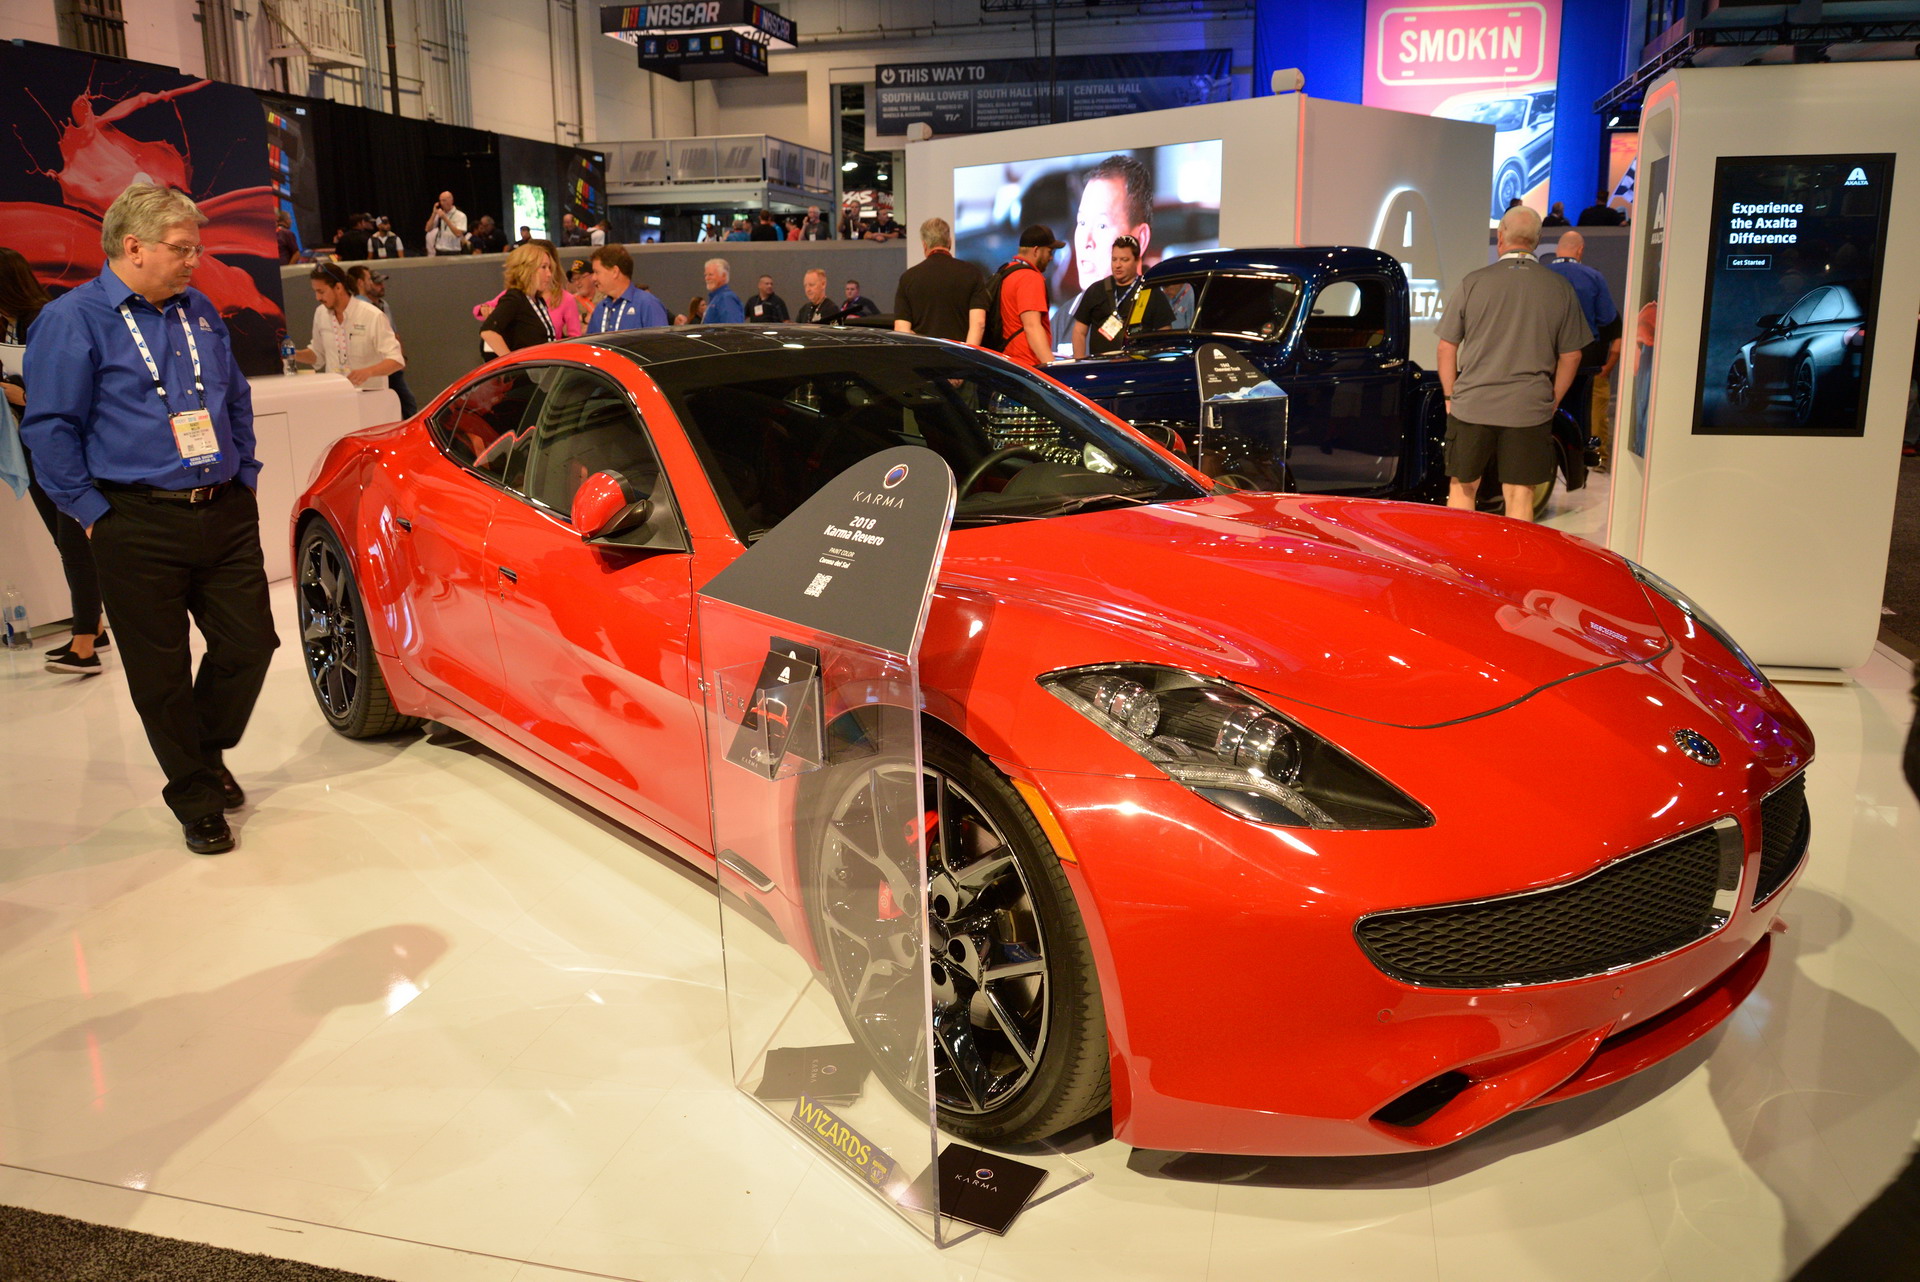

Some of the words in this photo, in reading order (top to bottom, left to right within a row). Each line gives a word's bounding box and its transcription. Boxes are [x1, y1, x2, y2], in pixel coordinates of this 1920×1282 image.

[646, 1, 720, 27] NASCAR
[763, 9, 790, 41] NASCAR
[1399, 25, 1523, 64] SMOK1N
[898, 68, 929, 84] THIS
[932, 66, 964, 82] WAY
[968, 65, 985, 80] TO
[881, 92, 912, 103] SOUTH
[913, 91, 936, 102] HALL
[937, 90, 969, 101] LOWER
[977, 88, 1007, 99] SOUTH
[1009, 87, 1032, 98] HALL
[1074, 84, 1116, 96] CENTRAL
[1117, 83, 1142, 94] HALL
[1732, 201, 1804, 216] Experience
[1730, 217, 1753, 229] the
[1755, 216, 1798, 229] Axalta
[1729, 232, 1798, 244] Difference
[852, 490, 905, 509] KARMA
[849, 515, 877, 530] 2018
[823, 524, 852, 541] Karma
[851, 530, 885, 546] Revero
[799, 1095, 872, 1166] WIZARDS
[954, 1173, 998, 1193] KARMA
